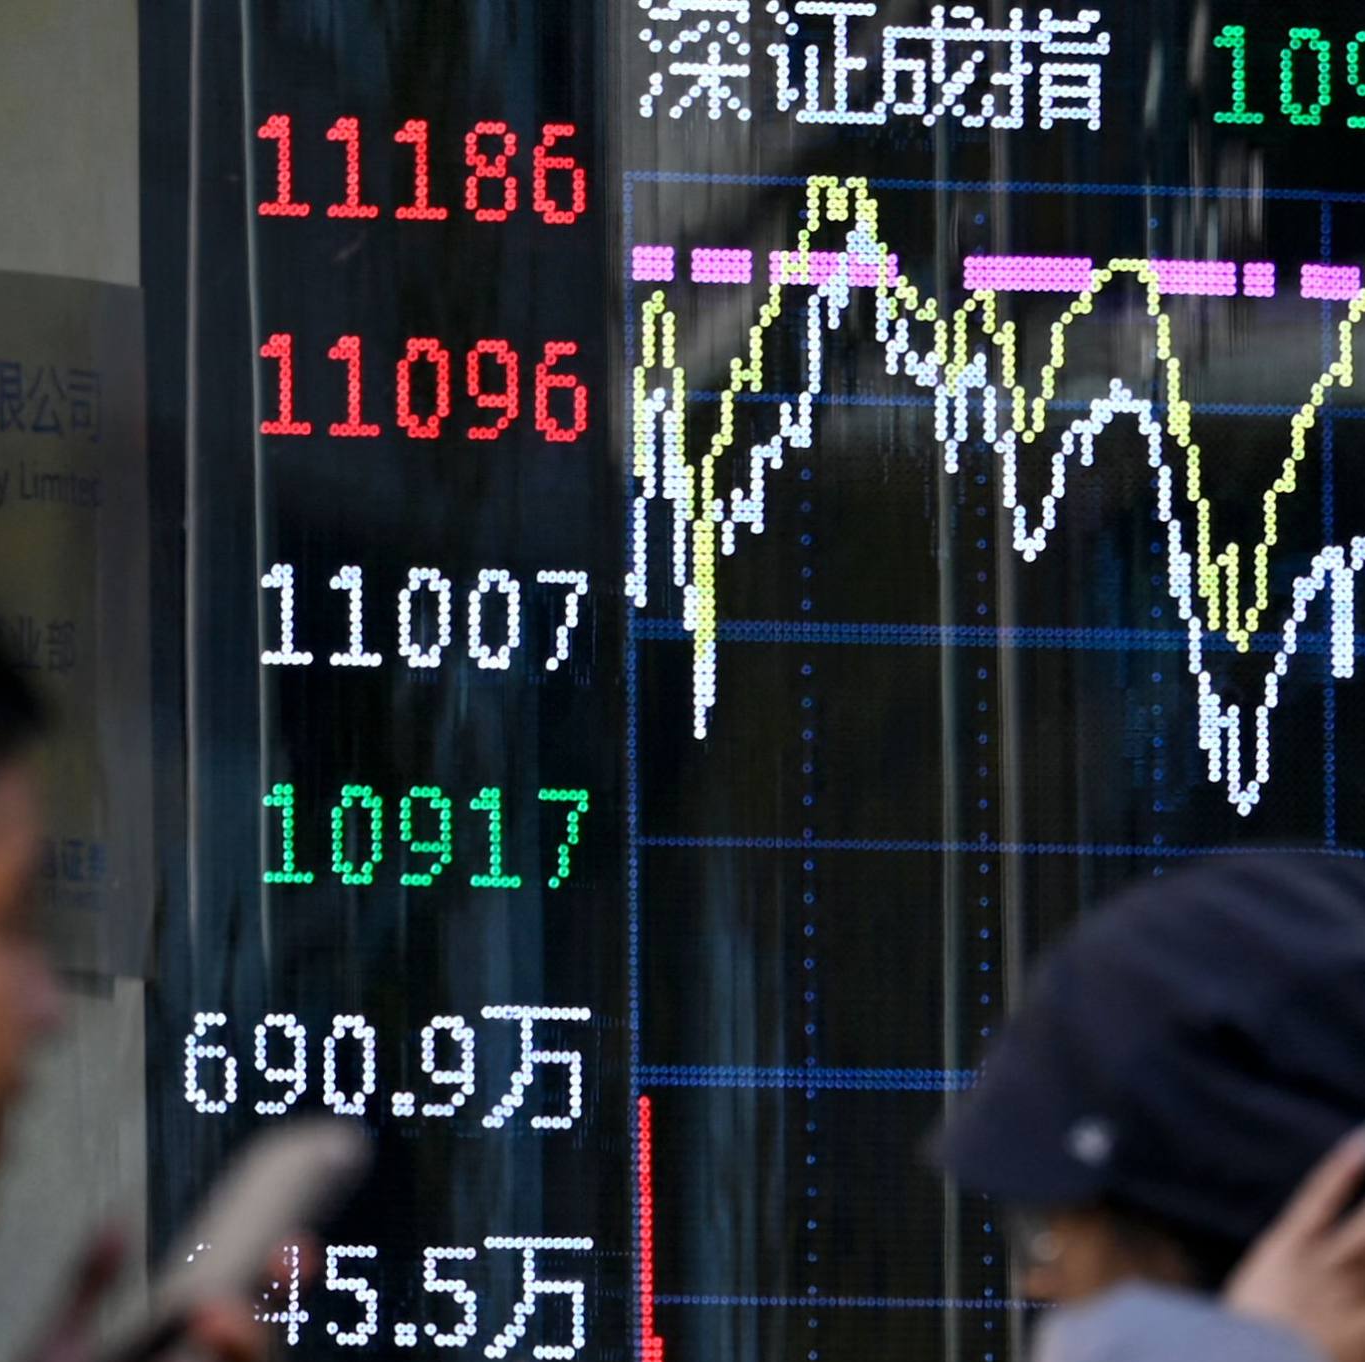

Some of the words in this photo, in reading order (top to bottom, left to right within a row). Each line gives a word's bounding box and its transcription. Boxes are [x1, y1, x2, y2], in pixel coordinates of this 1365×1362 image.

[638, 0, 1112, 133] 深证成指
[256, 113, 587, 225] 11186
[258, 332, 588, 444] 11096
[259, 562, 589, 672] 11007
[263, 780, 589, 890] 10917
[183, 1004, 592, 1130] 690.9万
[186, 1235, 594, 1360] 45.5万
